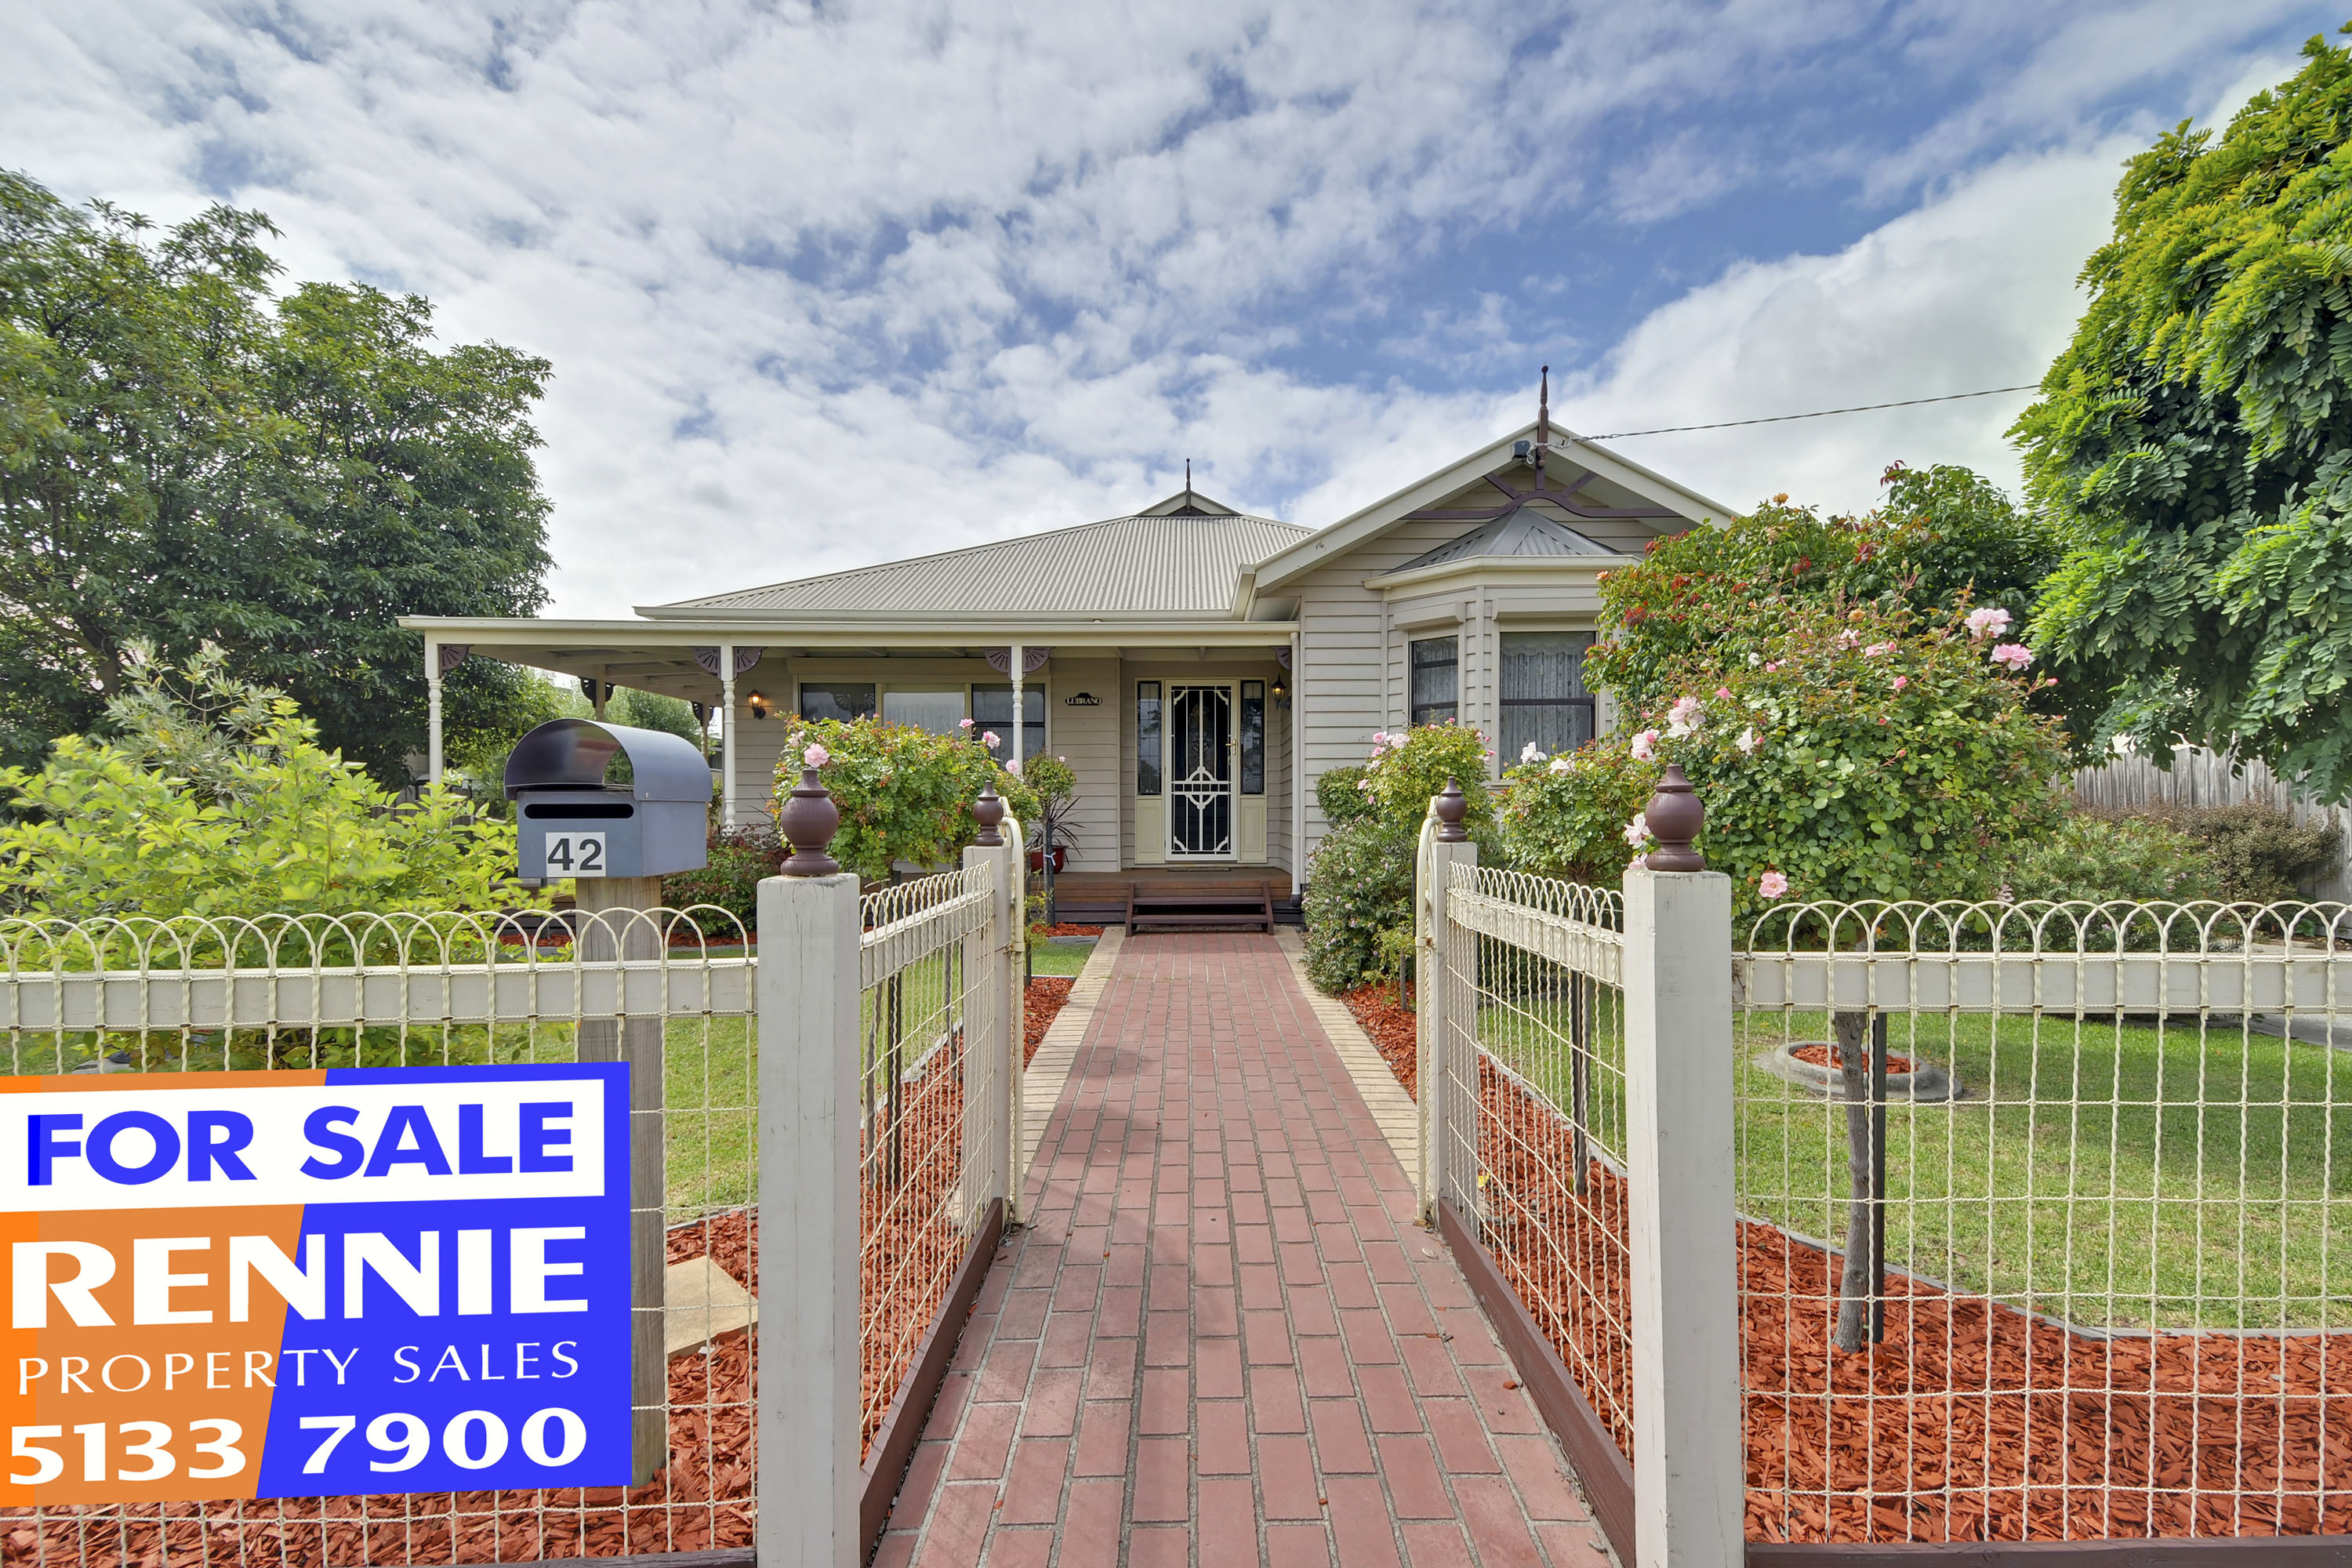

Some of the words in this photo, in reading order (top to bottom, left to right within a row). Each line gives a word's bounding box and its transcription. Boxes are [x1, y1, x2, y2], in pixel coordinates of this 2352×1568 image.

[547, 838, 603, 871] 42
[28, 1111, 257, 1185] FOR
[300, 1102, 573, 1180] SALE
[12, 1226, 588, 1329] RENNIE
[19, 1348, 359, 1395] PROPERTY
[394, 1341, 579, 1384] SALES
[10, 1419, 246, 1485] 5133
[299, 1407, 587, 1475] 7900
